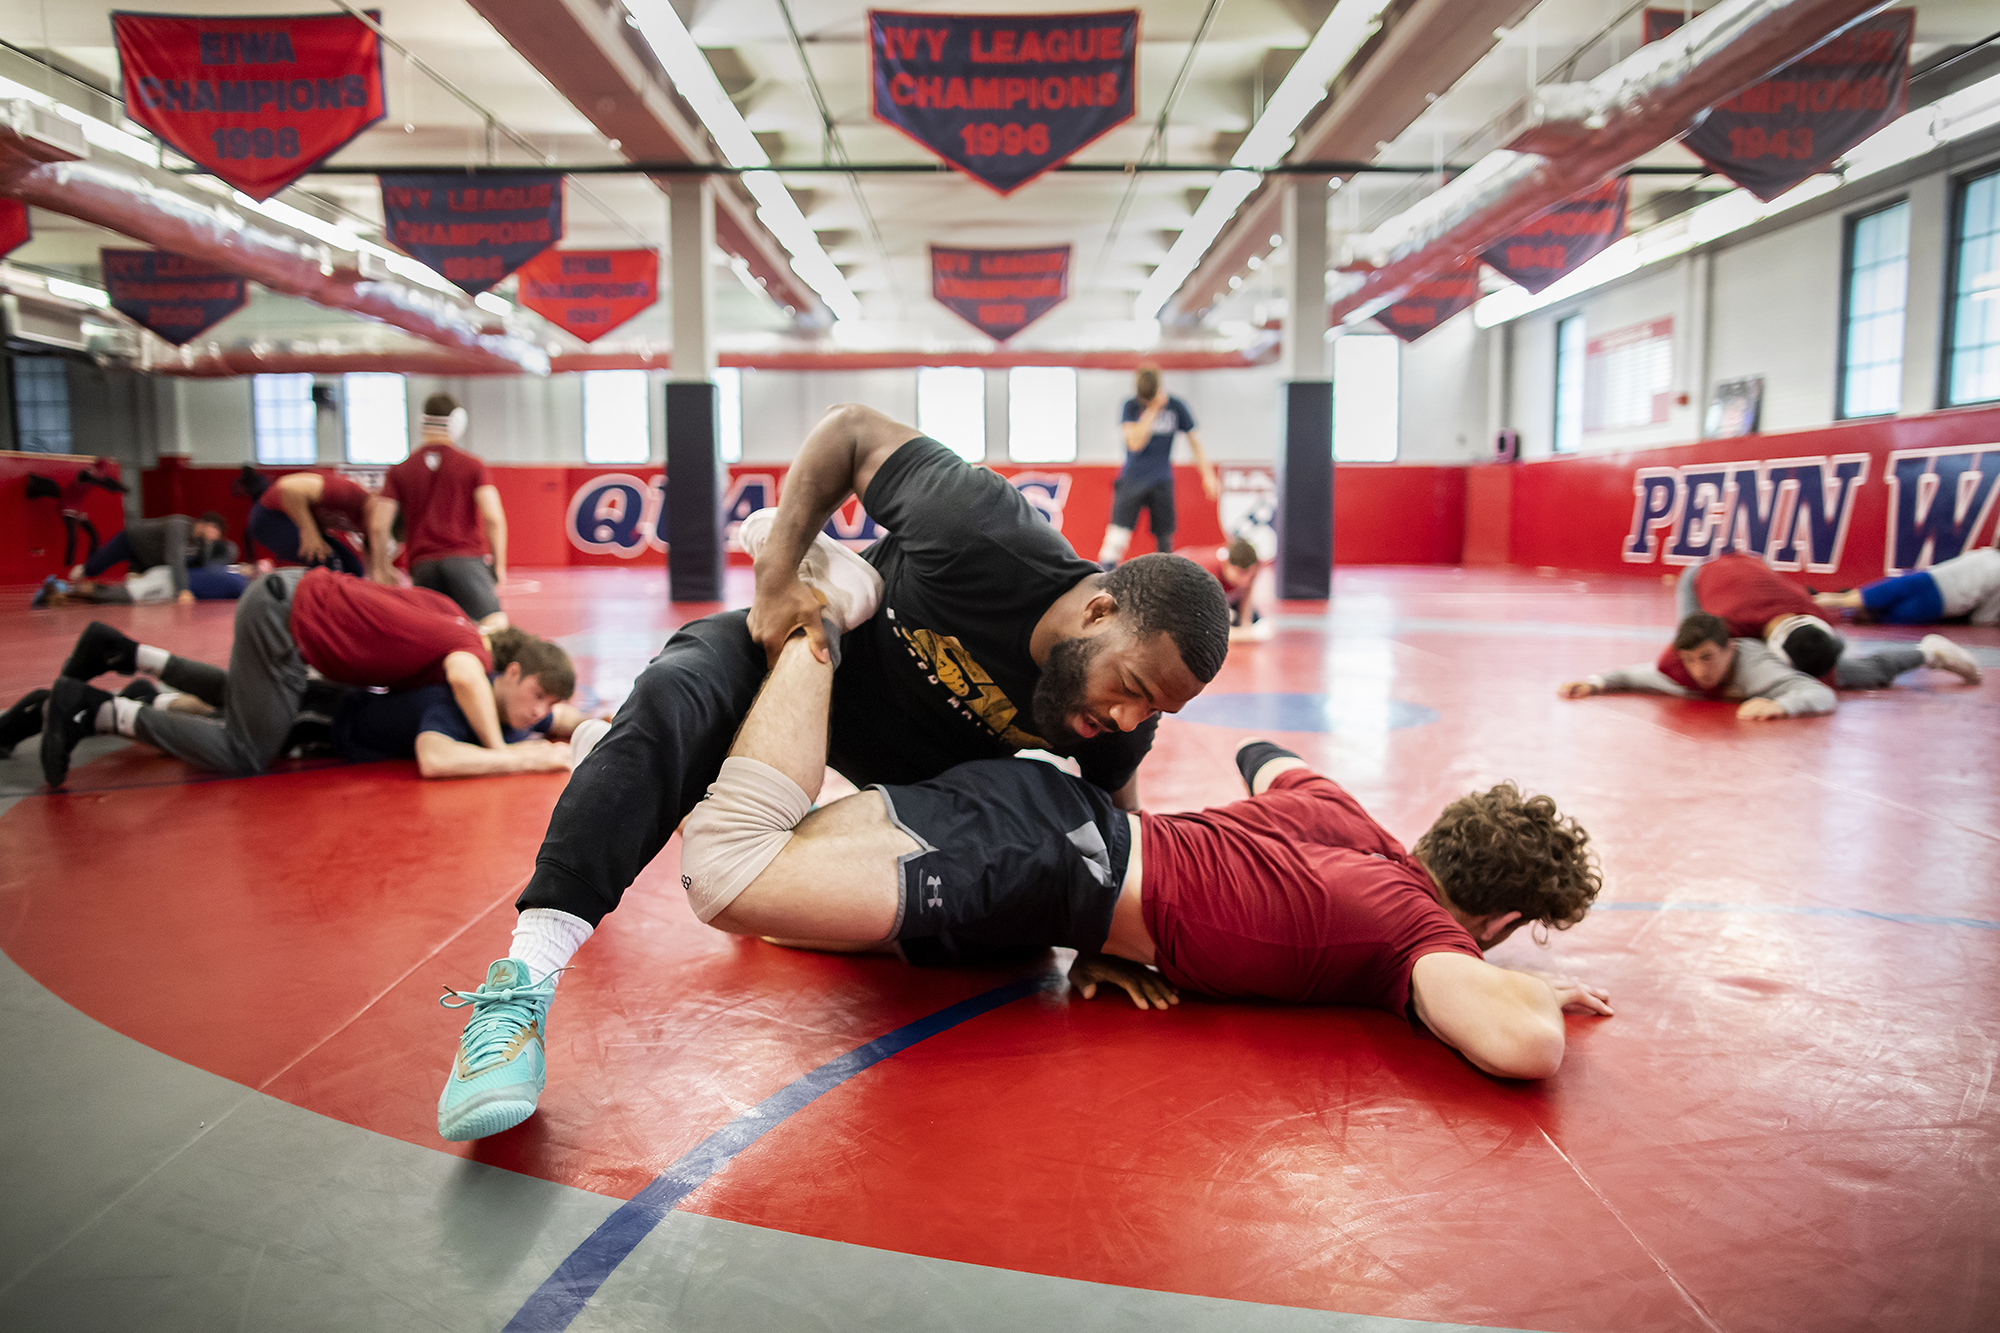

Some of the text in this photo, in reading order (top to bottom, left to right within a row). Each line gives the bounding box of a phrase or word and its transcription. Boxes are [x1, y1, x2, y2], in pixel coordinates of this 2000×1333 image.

[201, 32, 296, 65] EIWA
[884, 27, 1123, 63] IVY LEAGUE
[139, 75, 367, 113] CHAMPIONS
[890, 73, 1119, 110] CHAMPIONS
[211, 127, 300, 160] 1998
[960, 123, 1049, 156] 1996
[1729, 127, 1814, 159] 1943
[448, 183, 552, 212] LEAGUE
[395, 219, 551, 246] CHAMPIONS
[1623, 442, 2000, 578] PENN W
